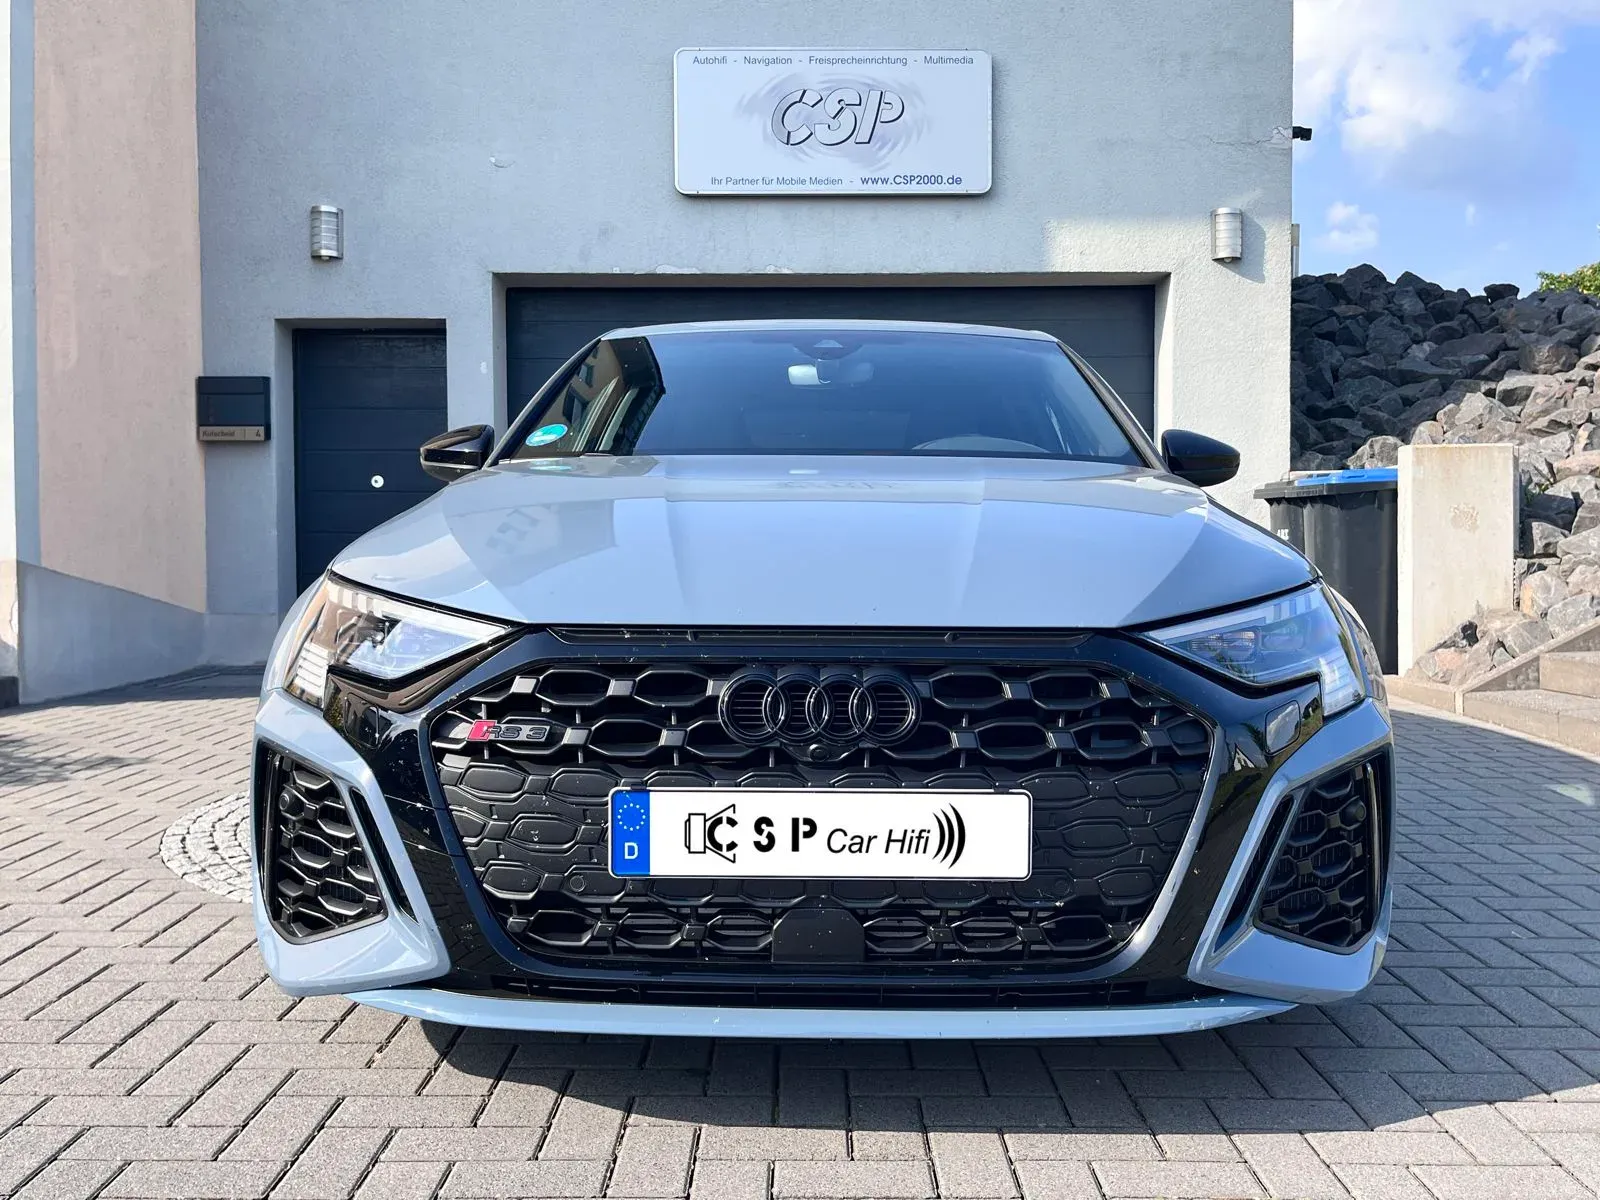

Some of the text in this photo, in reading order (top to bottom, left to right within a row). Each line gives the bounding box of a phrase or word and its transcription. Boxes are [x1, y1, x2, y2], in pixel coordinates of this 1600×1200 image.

[692, 55, 974, 67] Autohifi Navigation Freisprecheinrichtung Multimedia
[771, 87, 905, 146] CSP
[711, 174, 963, 186] Ihr Partner für Mobile Medien www.CSP2000.de
[826, 828, 878, 854] Car
[885, 829, 931, 854] Hifi
[624, 842, 639, 860] D
